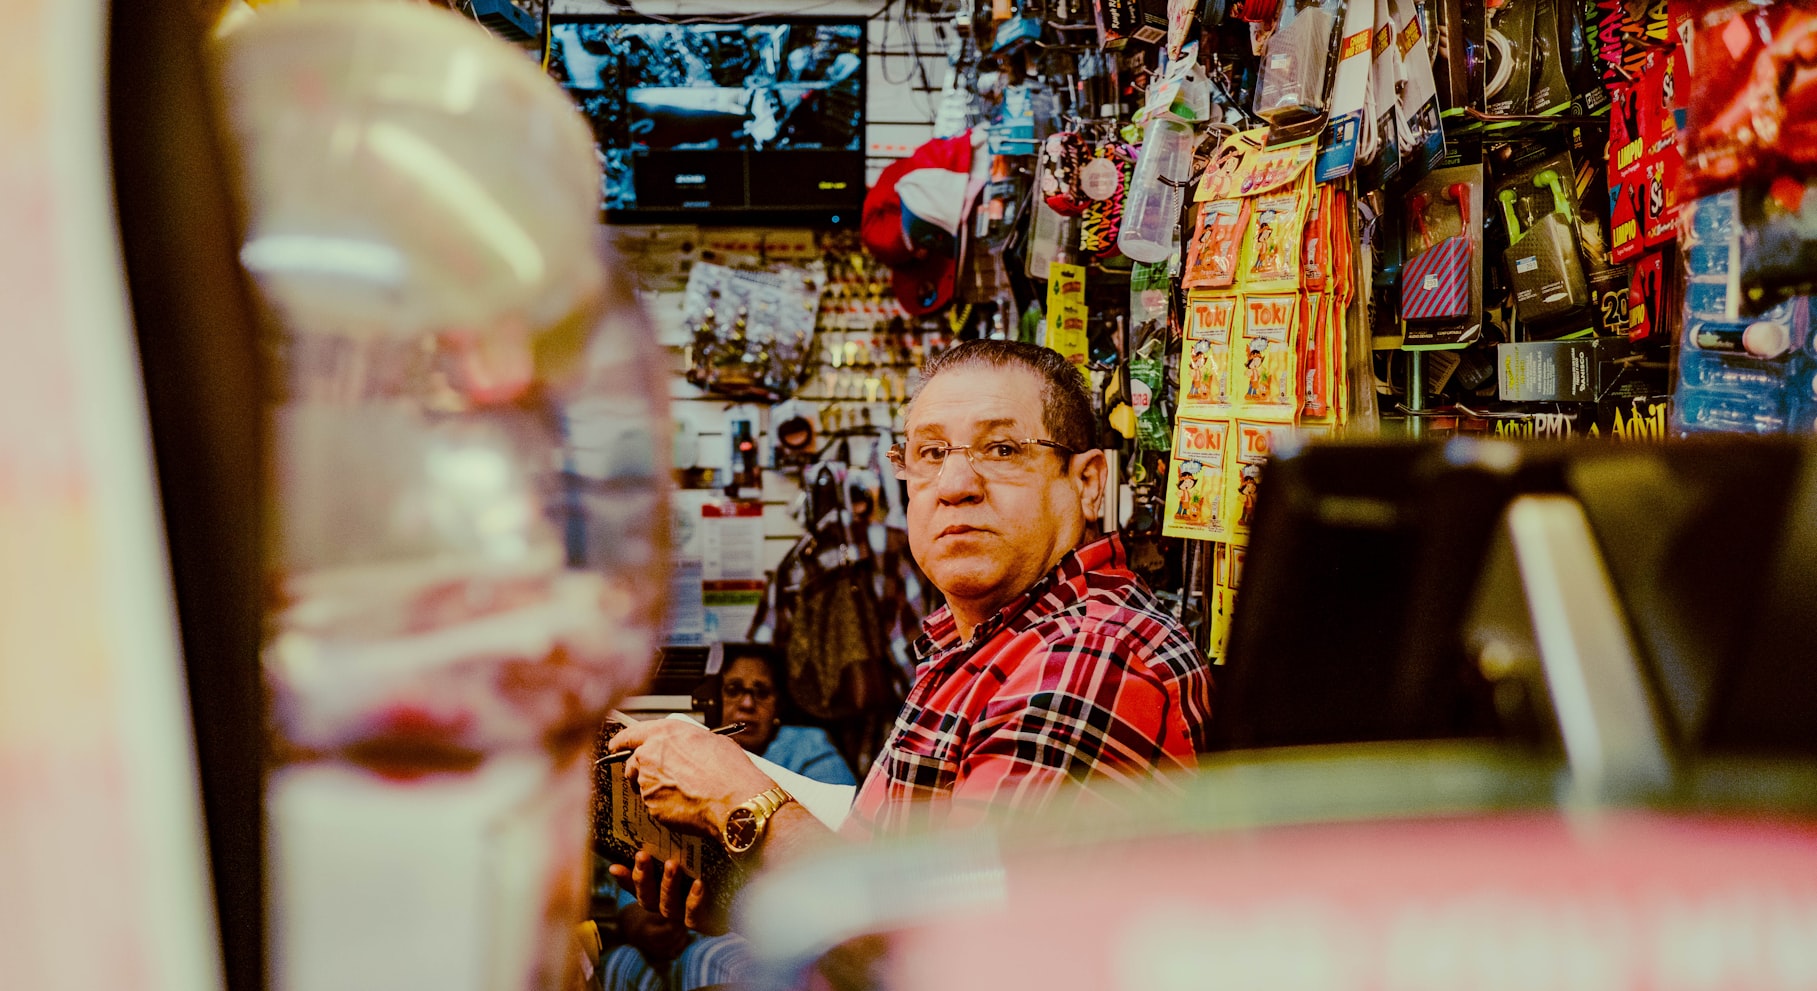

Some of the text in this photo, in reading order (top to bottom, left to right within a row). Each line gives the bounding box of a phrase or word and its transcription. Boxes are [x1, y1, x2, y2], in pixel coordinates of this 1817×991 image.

[1618, 137, 1643, 170] LIMPIO
[1613, 219, 1636, 248] LIMPIO
[1611, 403, 1666, 440] Advil
